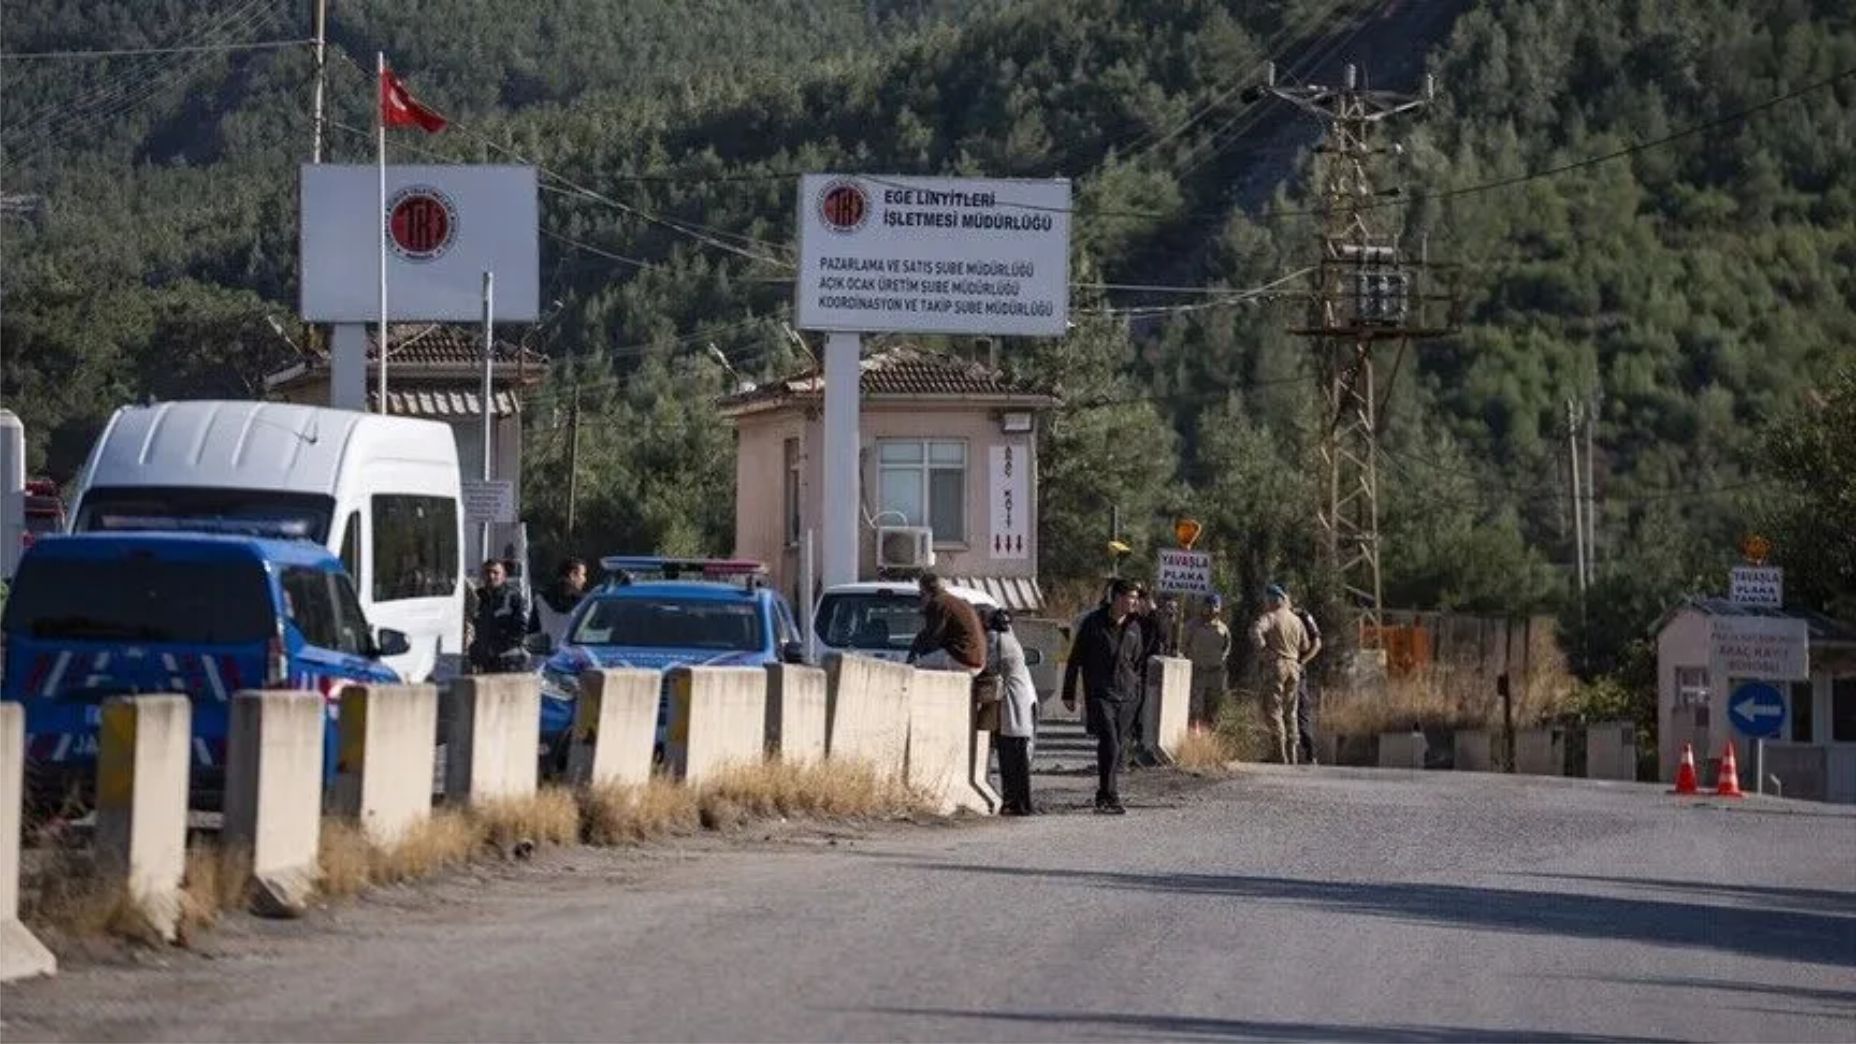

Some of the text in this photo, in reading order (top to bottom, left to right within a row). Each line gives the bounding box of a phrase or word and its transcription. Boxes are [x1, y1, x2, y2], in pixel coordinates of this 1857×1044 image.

[884, 189, 995, 207] EGE LİNYİTLERİ
[884, 208, 1053, 232] İŞLETMESİ MÜDÜRLÜĞÜ
[820, 257, 885, 272] PAZARLAMA
[887, 259, 900, 273] VE
[966, 261, 1034, 278] MÜDÜRLÜĞÜ
[818, 277, 845, 291] AÇIK
[846, 277, 875, 291] OCAK
[877, 277, 918, 293] ÜRETİM
[952, 280, 1020, 296] MÜDÜRLÜĞÜ
[818, 295, 902, 312] KOORDİNASYON
[904, 298, 917, 312] VE
[920, 297, 952, 313] TAKİP
[985, 300, 1054, 317] MÜDÜRLÜĞÜ
[1004, 446, 1013, 479] ARAÇ
[1161, 553, 1208, 569] YAVAŞLA
[1164, 569, 1204, 581] PLAKA
